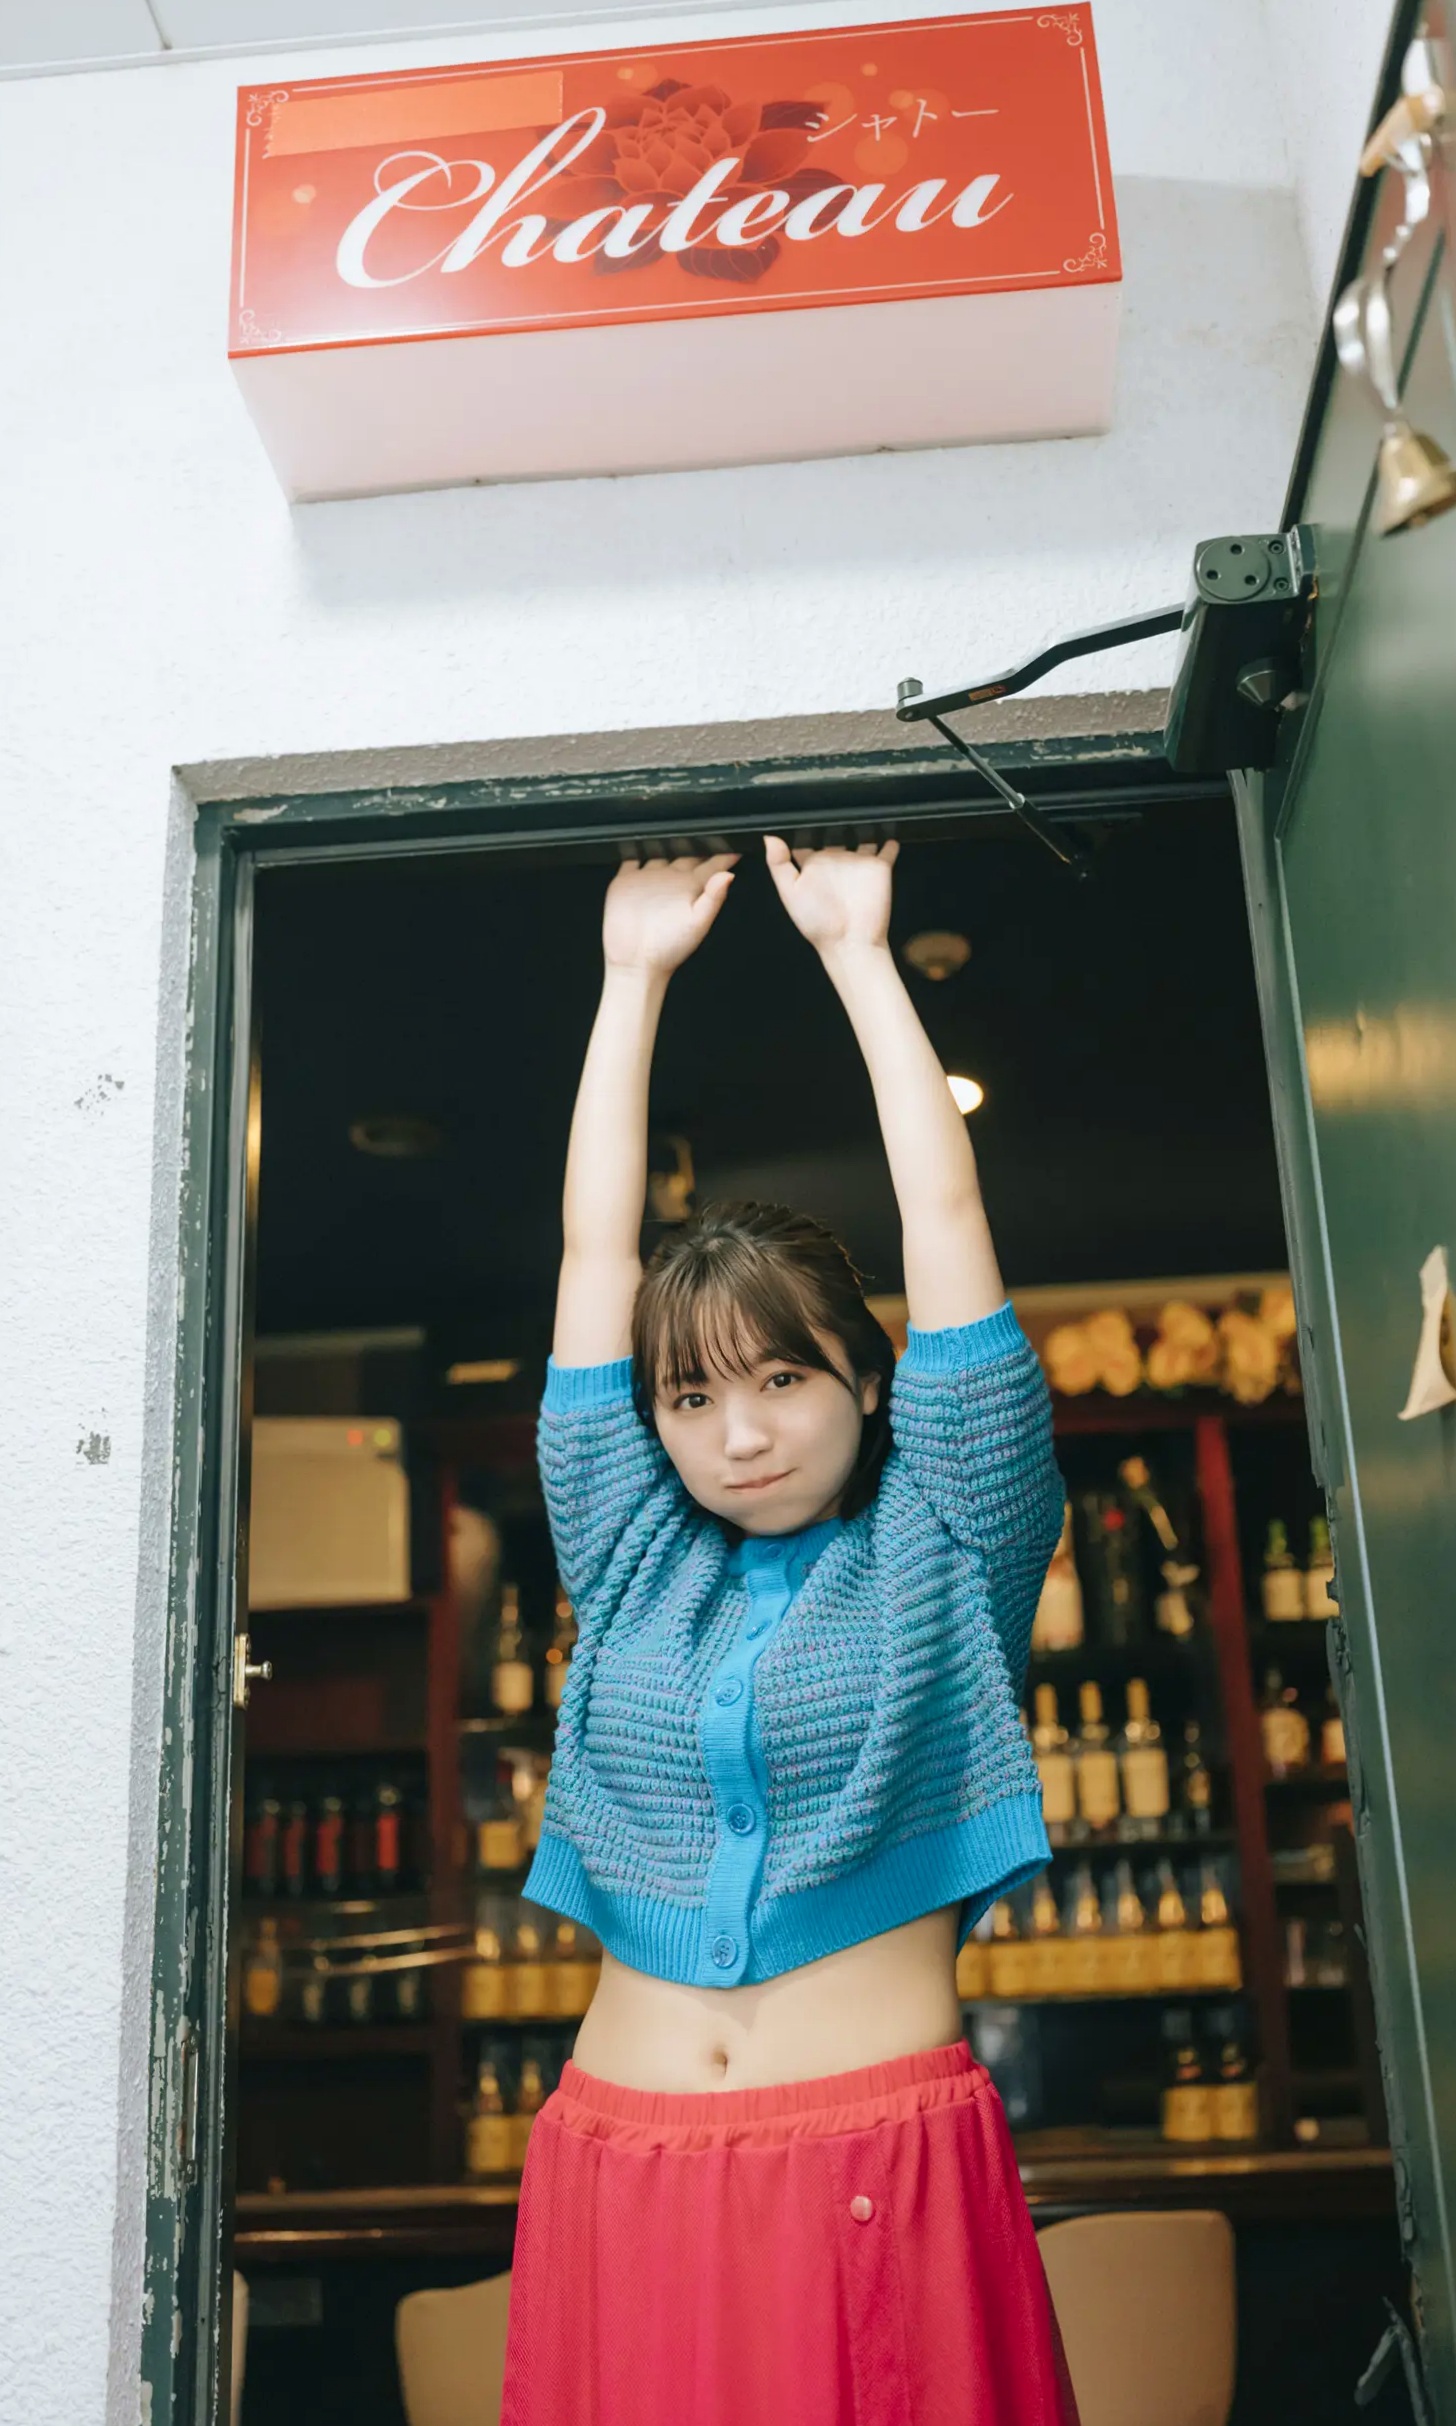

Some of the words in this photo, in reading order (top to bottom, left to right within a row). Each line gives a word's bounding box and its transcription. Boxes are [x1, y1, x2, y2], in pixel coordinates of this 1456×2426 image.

[805, 98, 999, 143] シャトー
[336, 107, 1014, 288] Chateau
